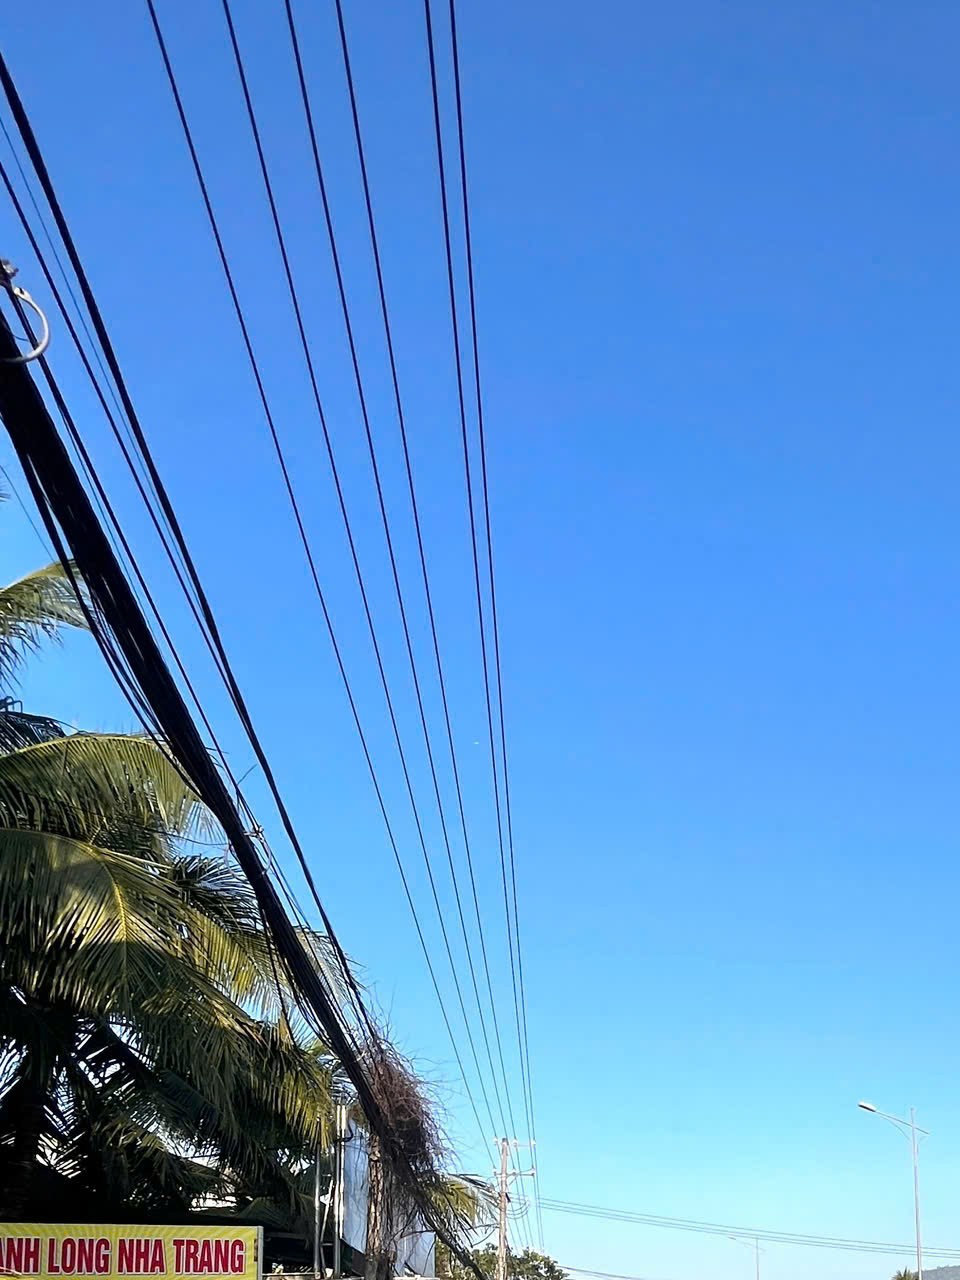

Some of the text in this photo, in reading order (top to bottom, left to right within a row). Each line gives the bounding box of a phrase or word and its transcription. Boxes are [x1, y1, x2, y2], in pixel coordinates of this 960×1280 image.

[47, 1237, 110, 1274] LONG
[117, 1238, 165, 1274] NHA
[172, 1238, 245, 1274] TRANG
